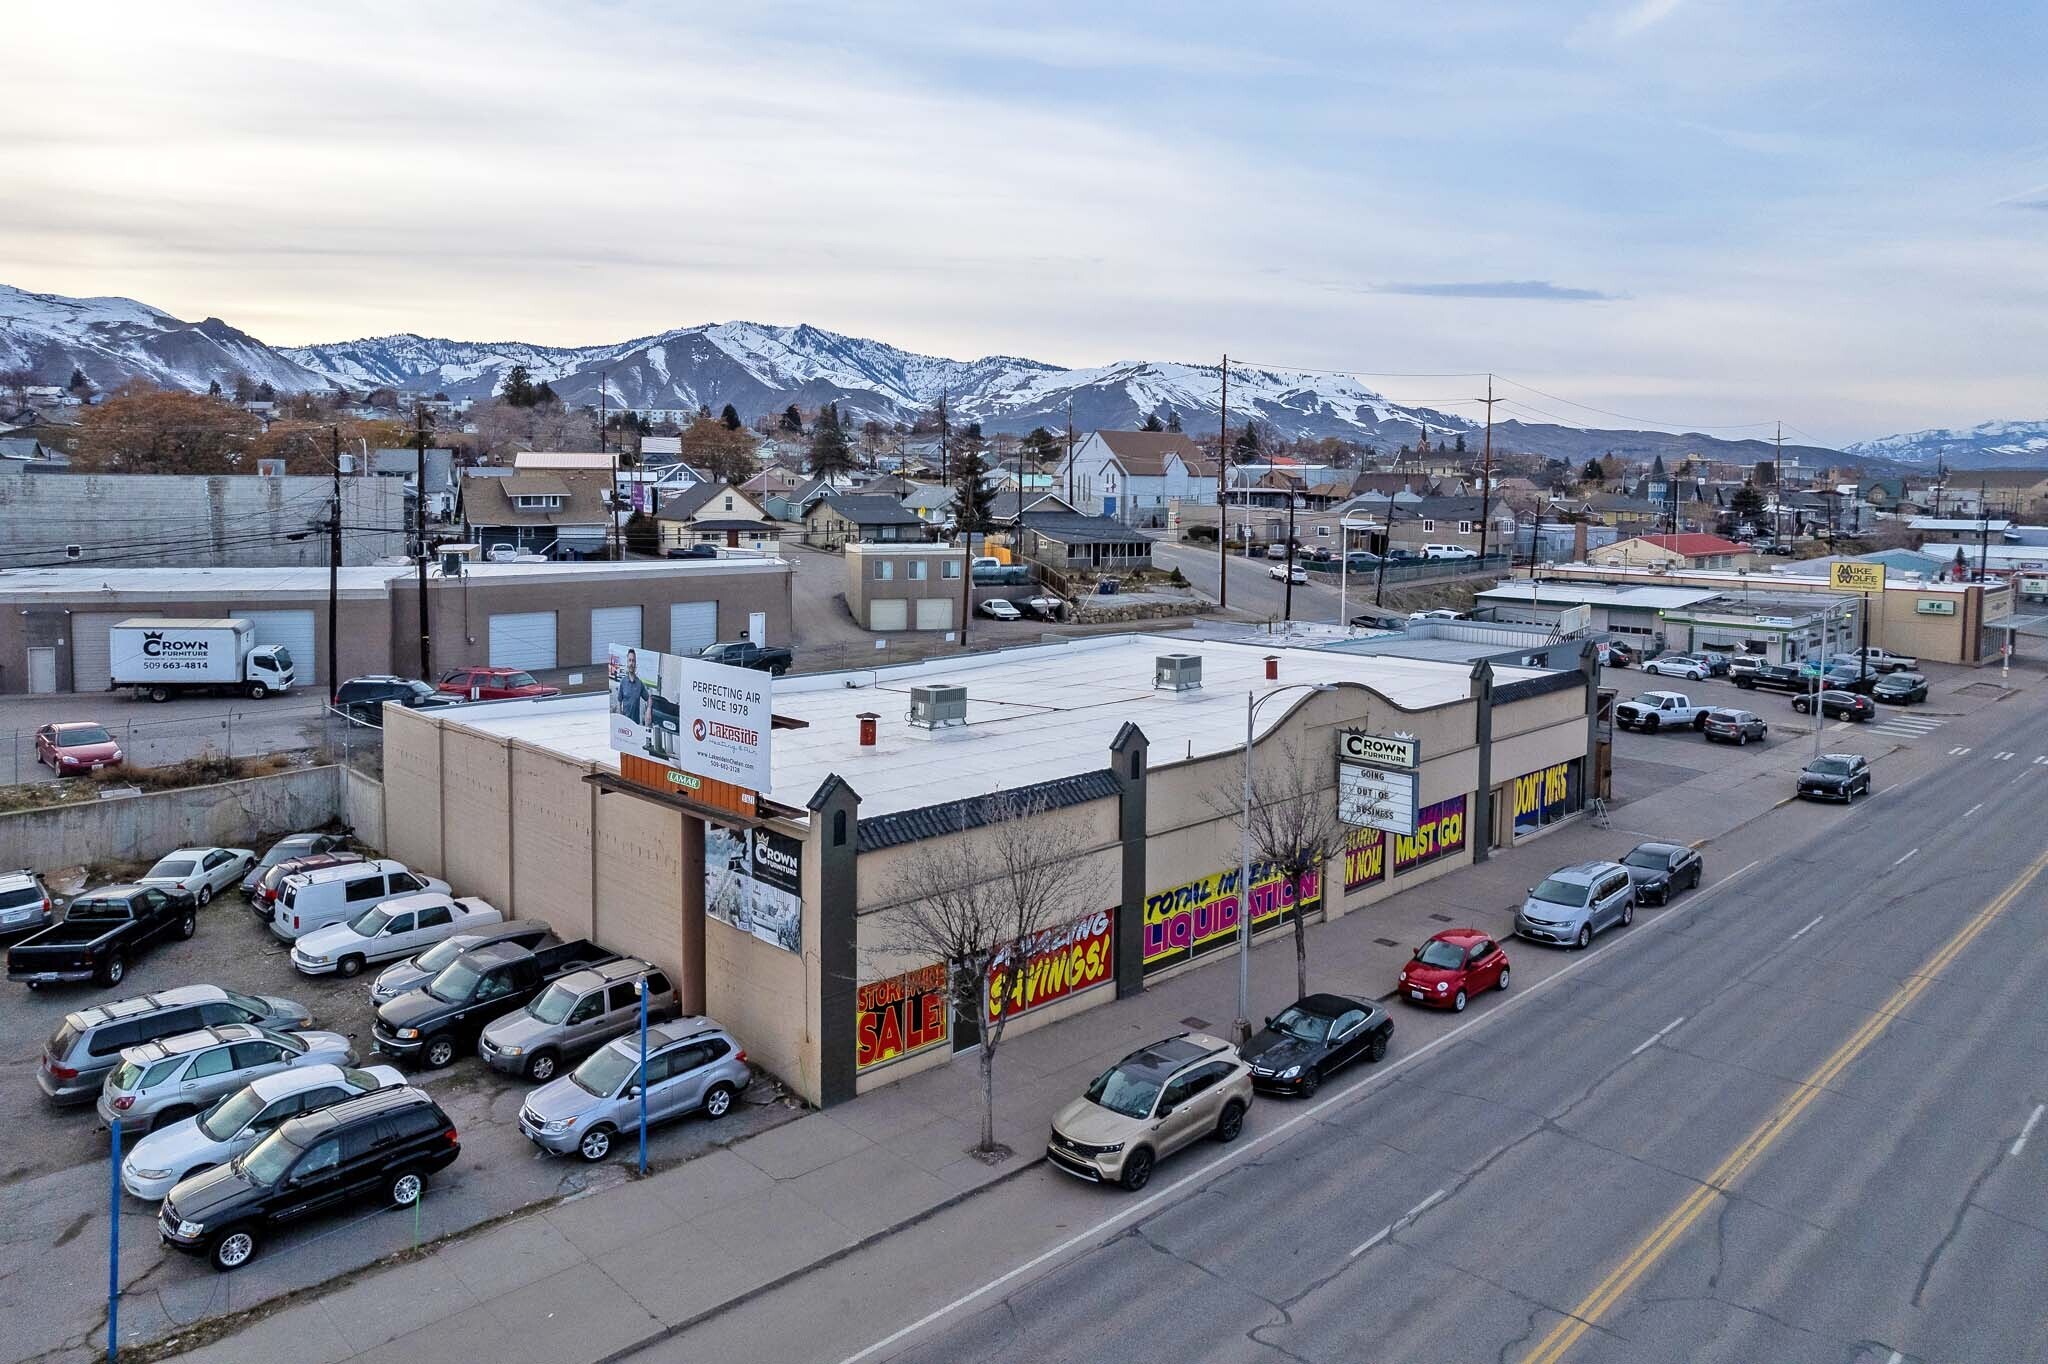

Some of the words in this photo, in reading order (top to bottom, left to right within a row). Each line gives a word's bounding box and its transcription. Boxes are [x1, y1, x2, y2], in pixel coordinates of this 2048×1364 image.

[1837, 574, 1879, 584] WOLFE
[1838, 565, 1873, 576] MIKE
[143, 639, 209, 657] CROWN
[143, 661, 160, 670] 509
[162, 661, 209, 670] 663-4814
[692, 680, 743, 701] PERFECTING
[745, 690, 761, 704] AIR
[702, 696, 727, 712] SINCE
[729, 702, 749, 716] 1978
[708, 720, 759, 747] Lakeside
[1346, 735, 1407, 756] CROWN
[1363, 751, 1406, 763] FURNITURE
[669, 772, 698, 788] LAMAR
[1361, 769, 1385, 781] GOING
[1356, 787, 1373, 797] OUT
[1355, 804, 1394, 820] BUSINESS
[1395, 821, 1437, 864] MUST
[1437, 812, 1463, 847] GO!
[756, 843, 798, 869] CROWN
[1356, 844, 1383, 882] NOW!
[767, 859, 798, 877] FURNITURE
[1147, 880, 1212, 919] TOTAL
[989, 933, 1111, 1016] SAVINGS!
